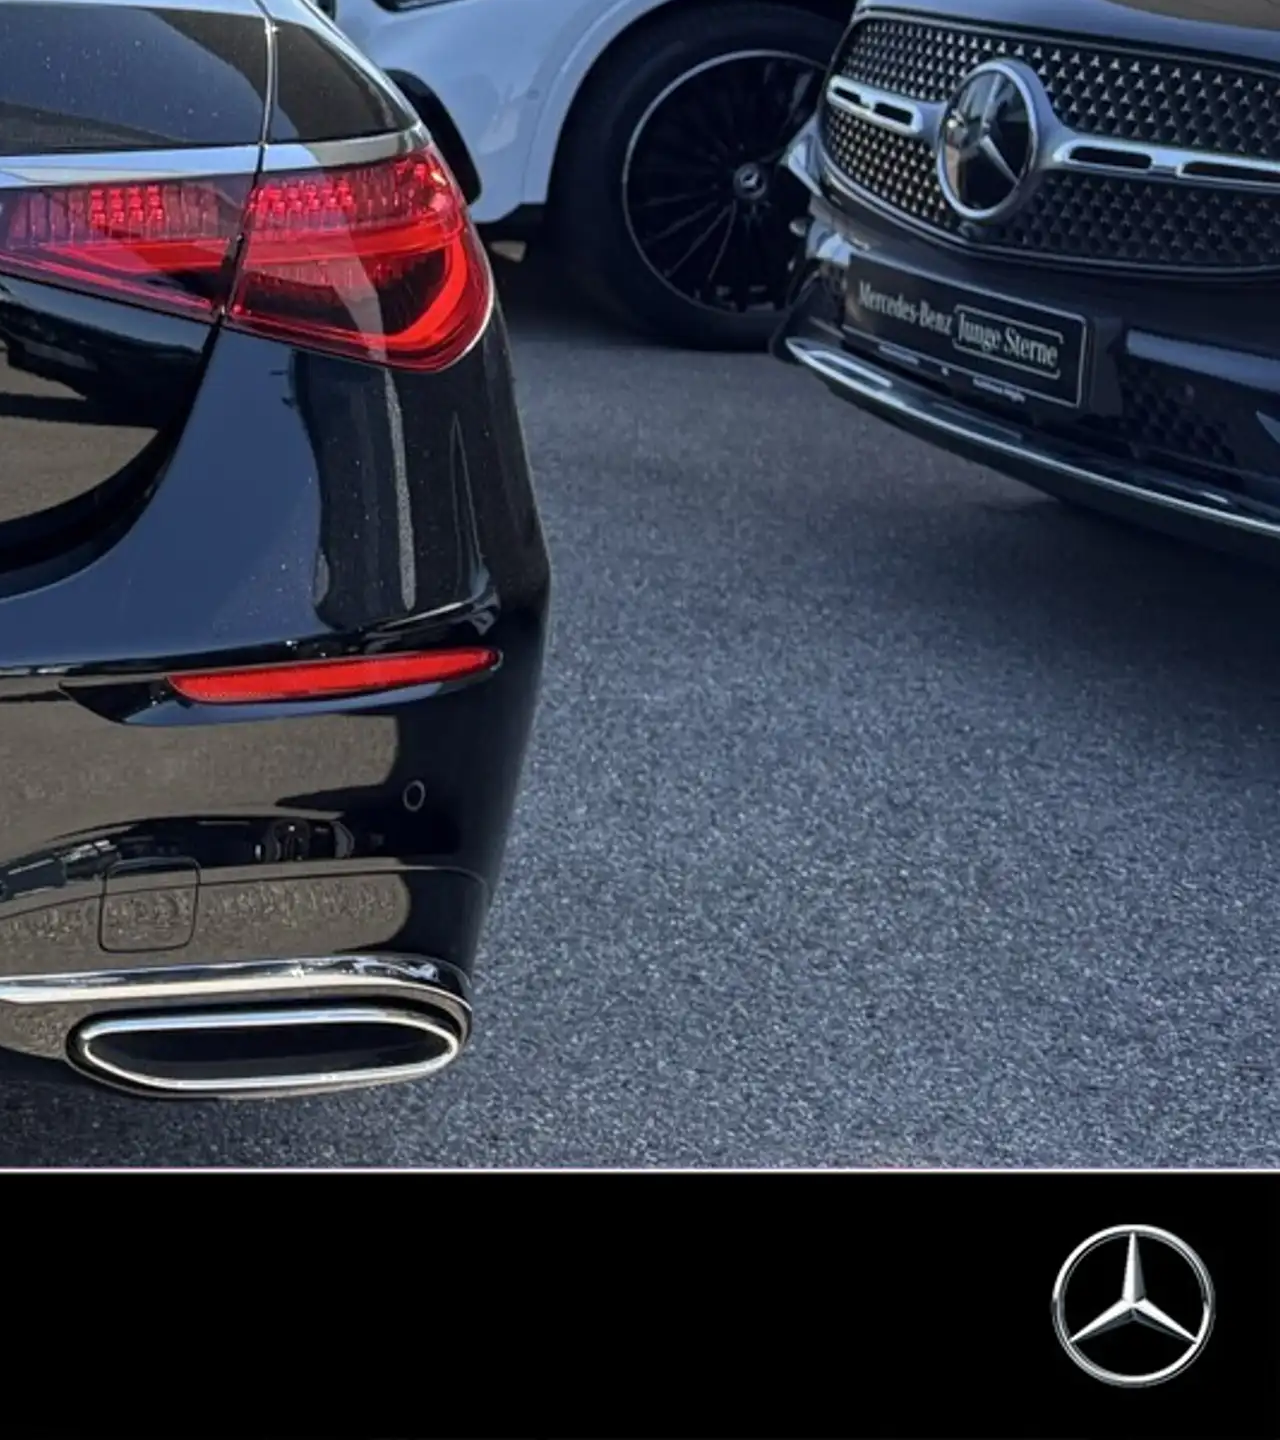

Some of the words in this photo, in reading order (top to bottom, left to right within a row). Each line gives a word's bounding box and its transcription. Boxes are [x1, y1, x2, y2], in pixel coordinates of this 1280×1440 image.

[857, 280, 954, 336] Mercedes-Benz
[957, 312, 1002, 351] Junge
[1003, 326, 1059, 368] Sterne
